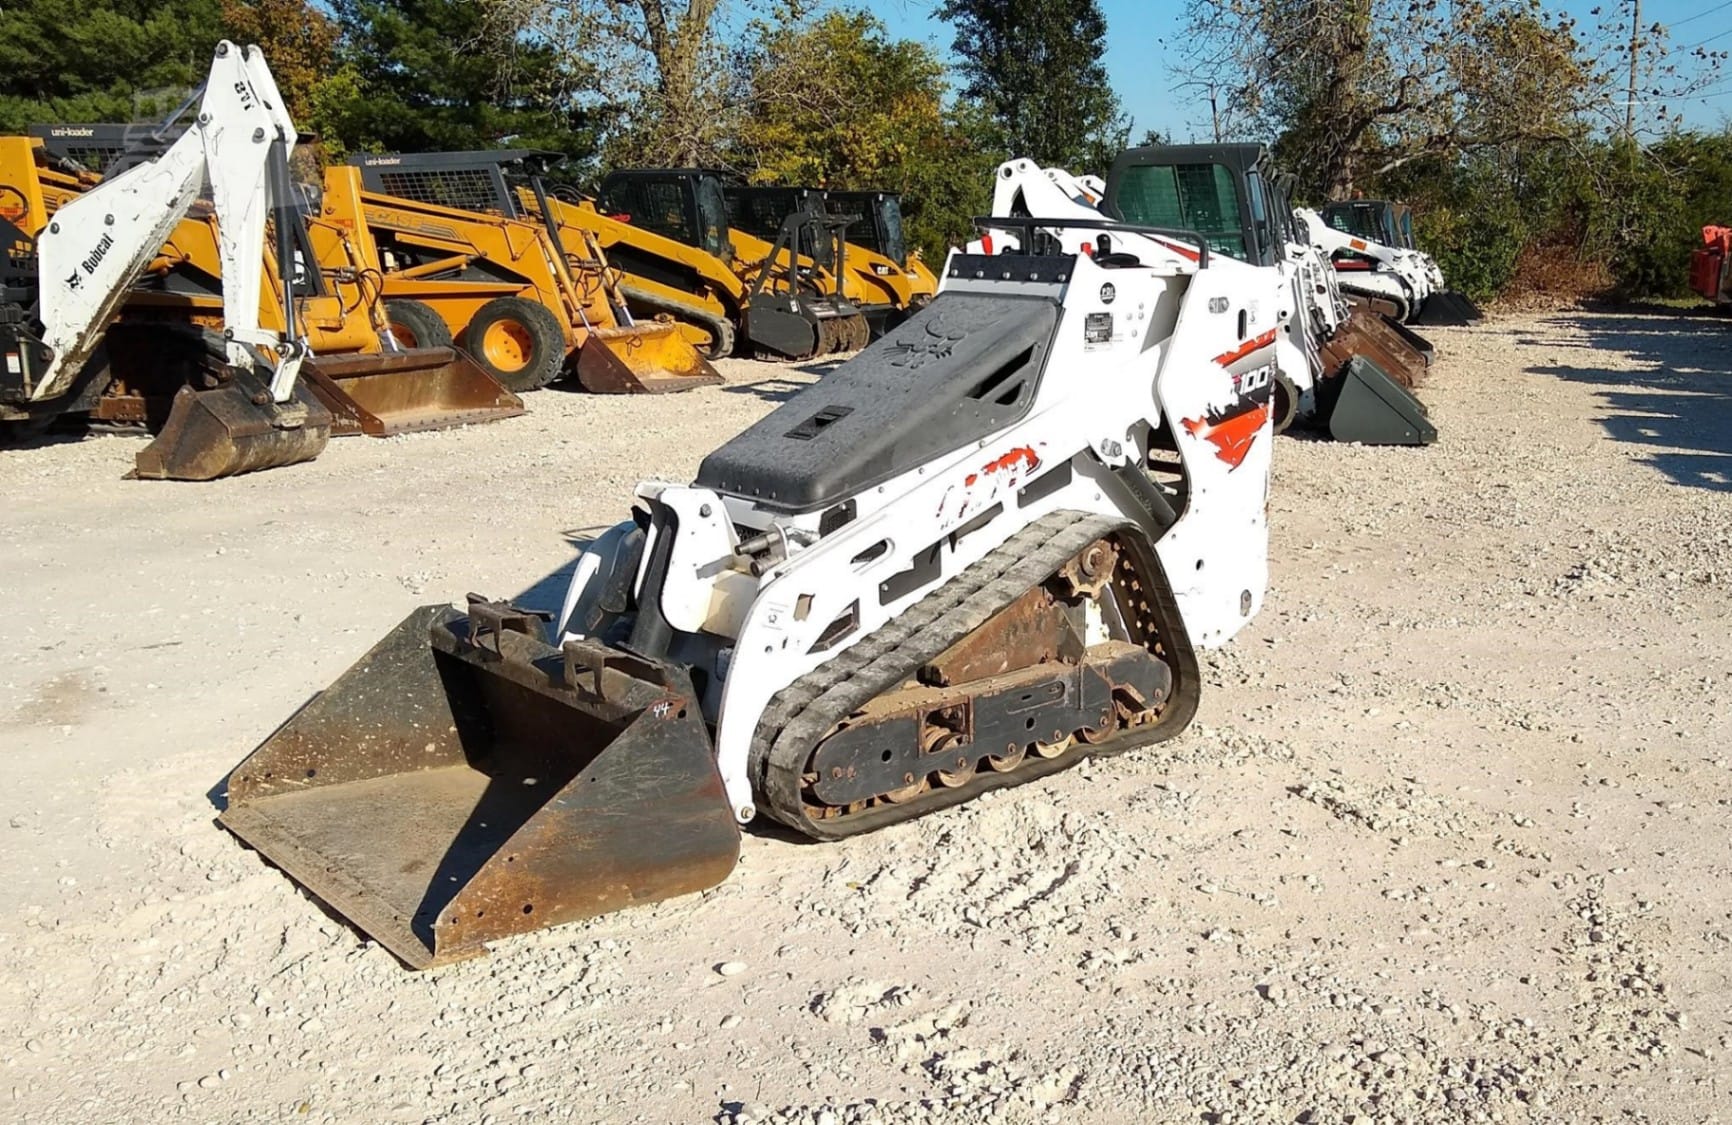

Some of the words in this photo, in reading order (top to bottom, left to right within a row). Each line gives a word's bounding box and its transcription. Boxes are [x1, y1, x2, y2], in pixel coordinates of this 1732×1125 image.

[51, 127, 94, 137] uni-loader
[81, 232, 114, 275] Bobcat
[653, 701, 669, 718] 44
